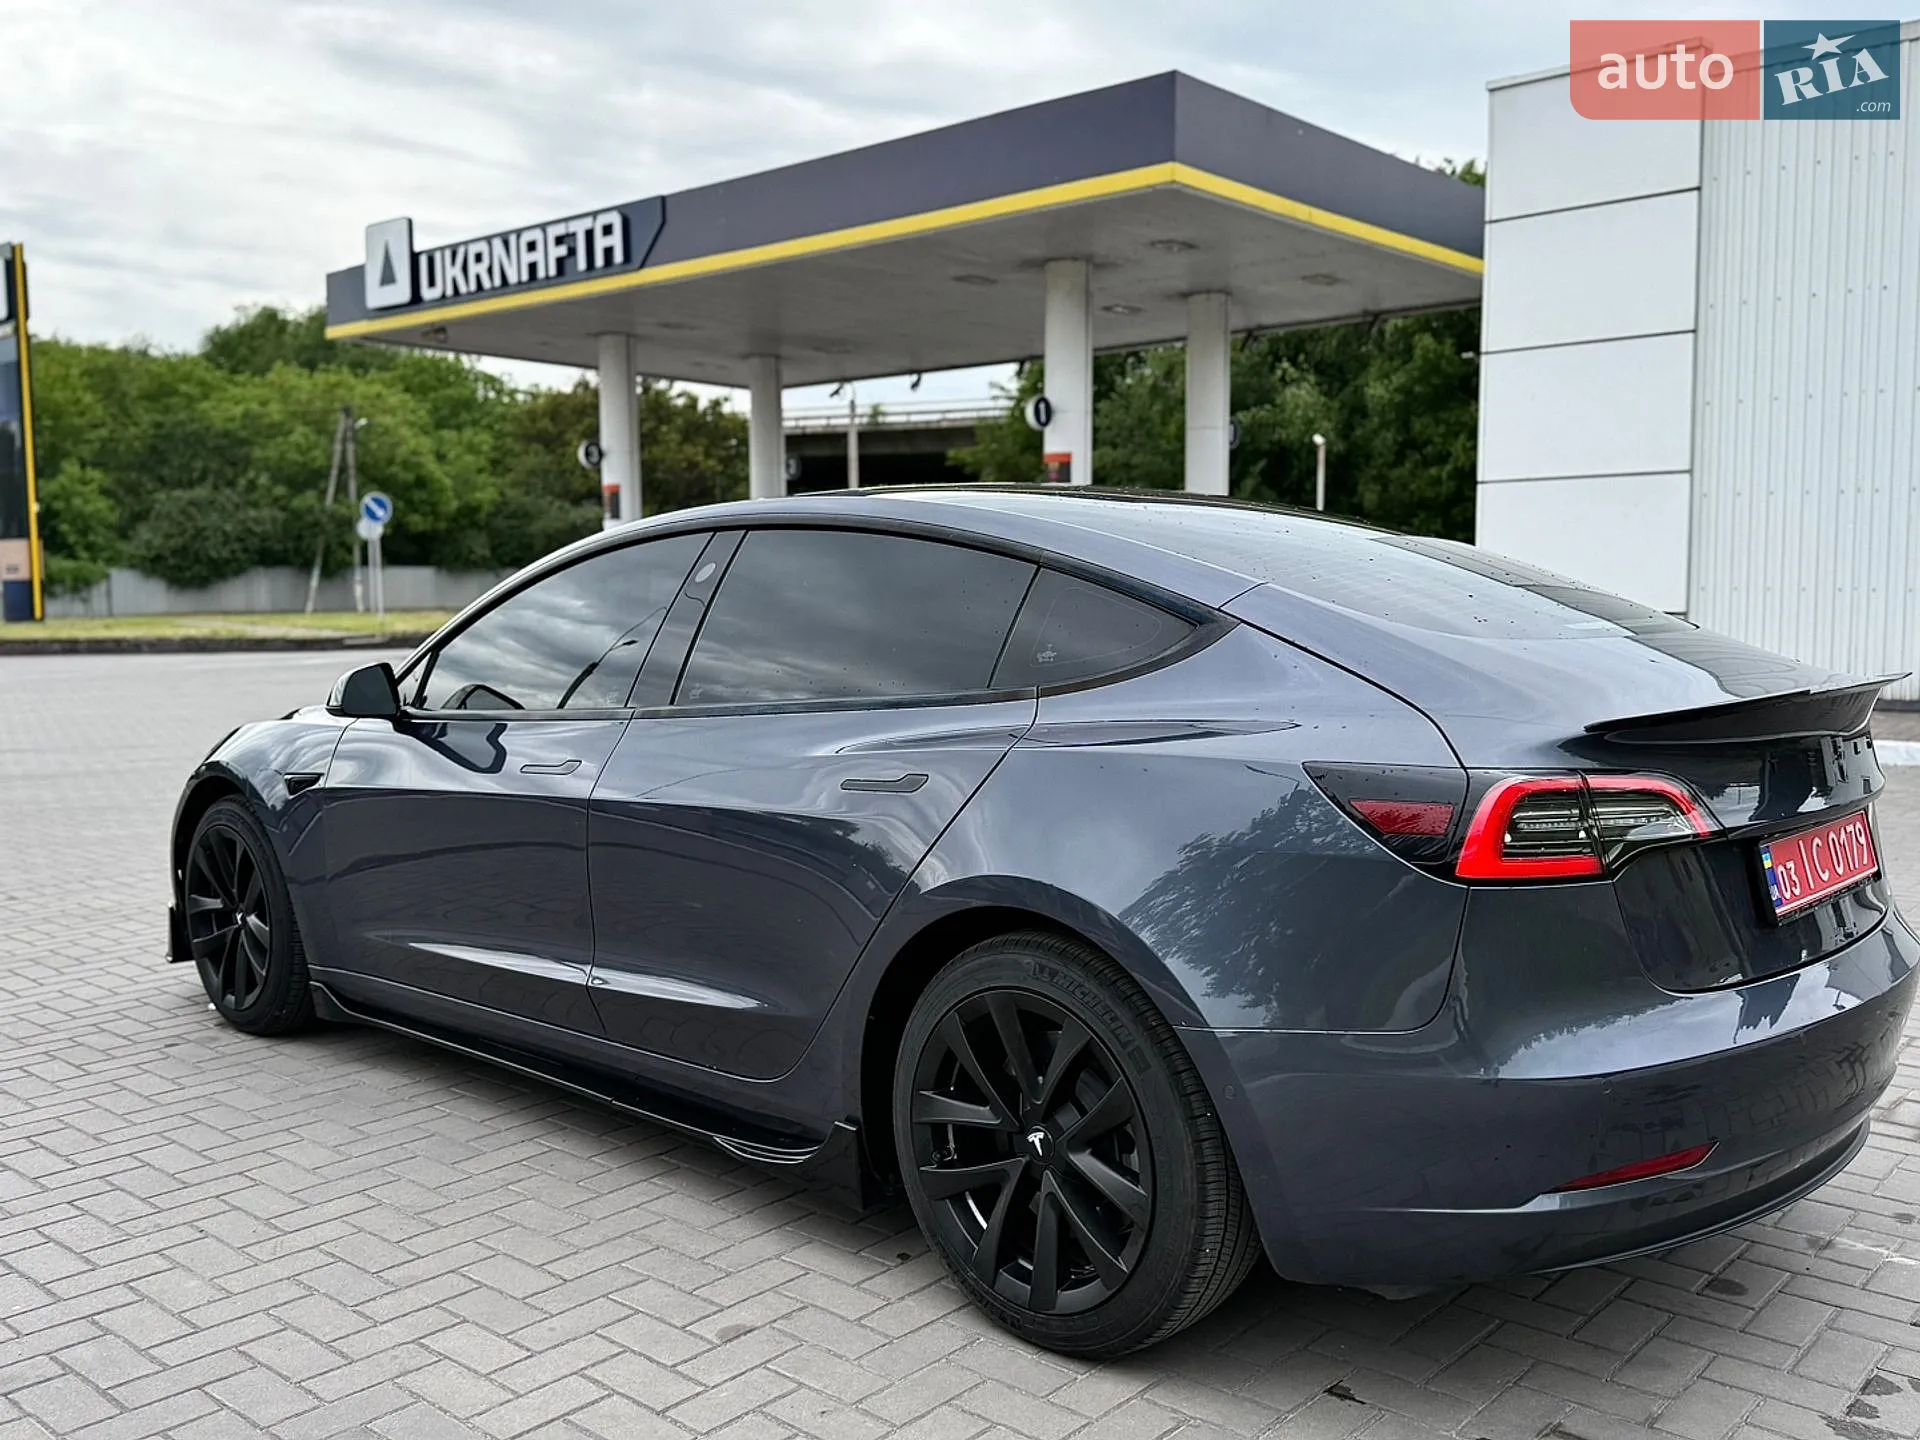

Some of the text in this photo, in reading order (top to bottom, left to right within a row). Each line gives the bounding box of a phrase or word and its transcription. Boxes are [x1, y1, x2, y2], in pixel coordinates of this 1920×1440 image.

[419, 210, 625, 301] UKRNAFTA
[1777, 860, 1801, 900] 03
[1827, 821, 1868, 876] 0179
